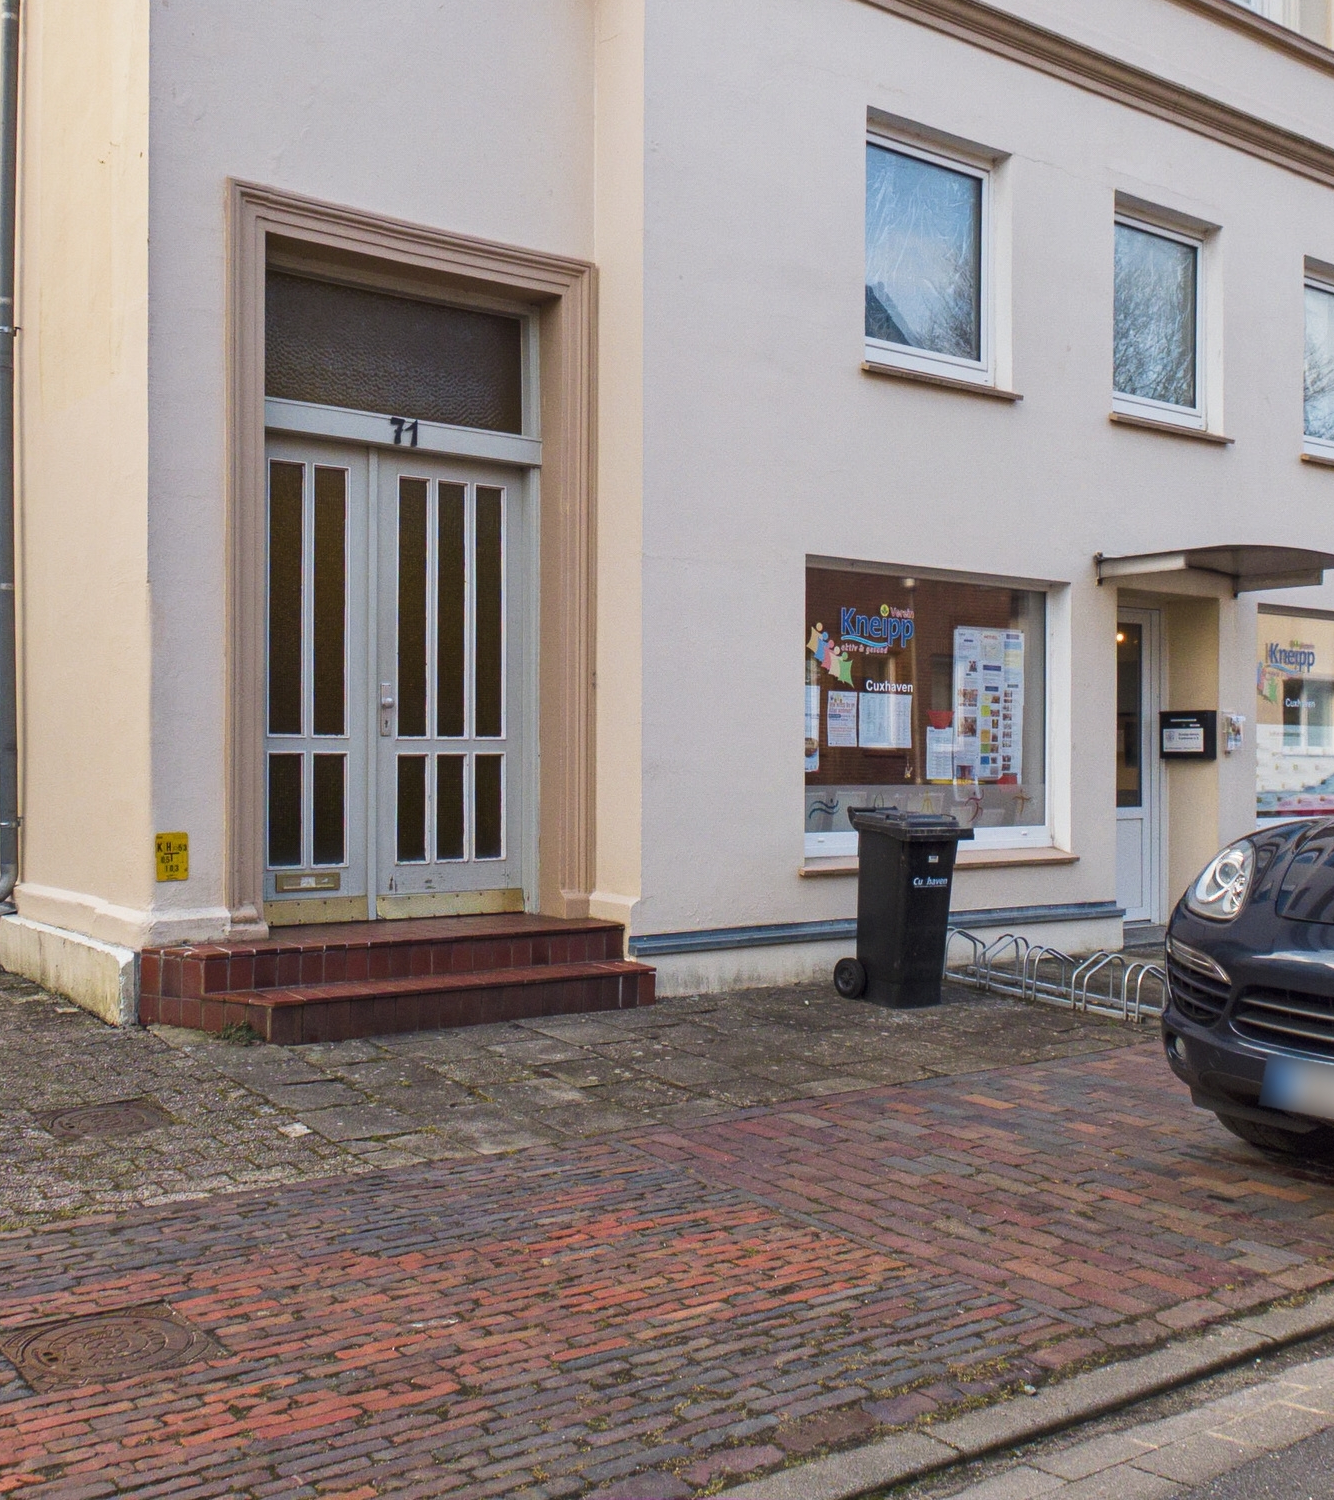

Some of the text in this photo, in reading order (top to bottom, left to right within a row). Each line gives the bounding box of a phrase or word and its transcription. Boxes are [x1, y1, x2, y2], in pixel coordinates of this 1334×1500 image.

[390, 417, 418, 447] 71
[841, 605, 915, 648] Kneipp
[1269, 642, 1315, 673] Kneipp
[865, 679, 914, 693] Cuxhaven
